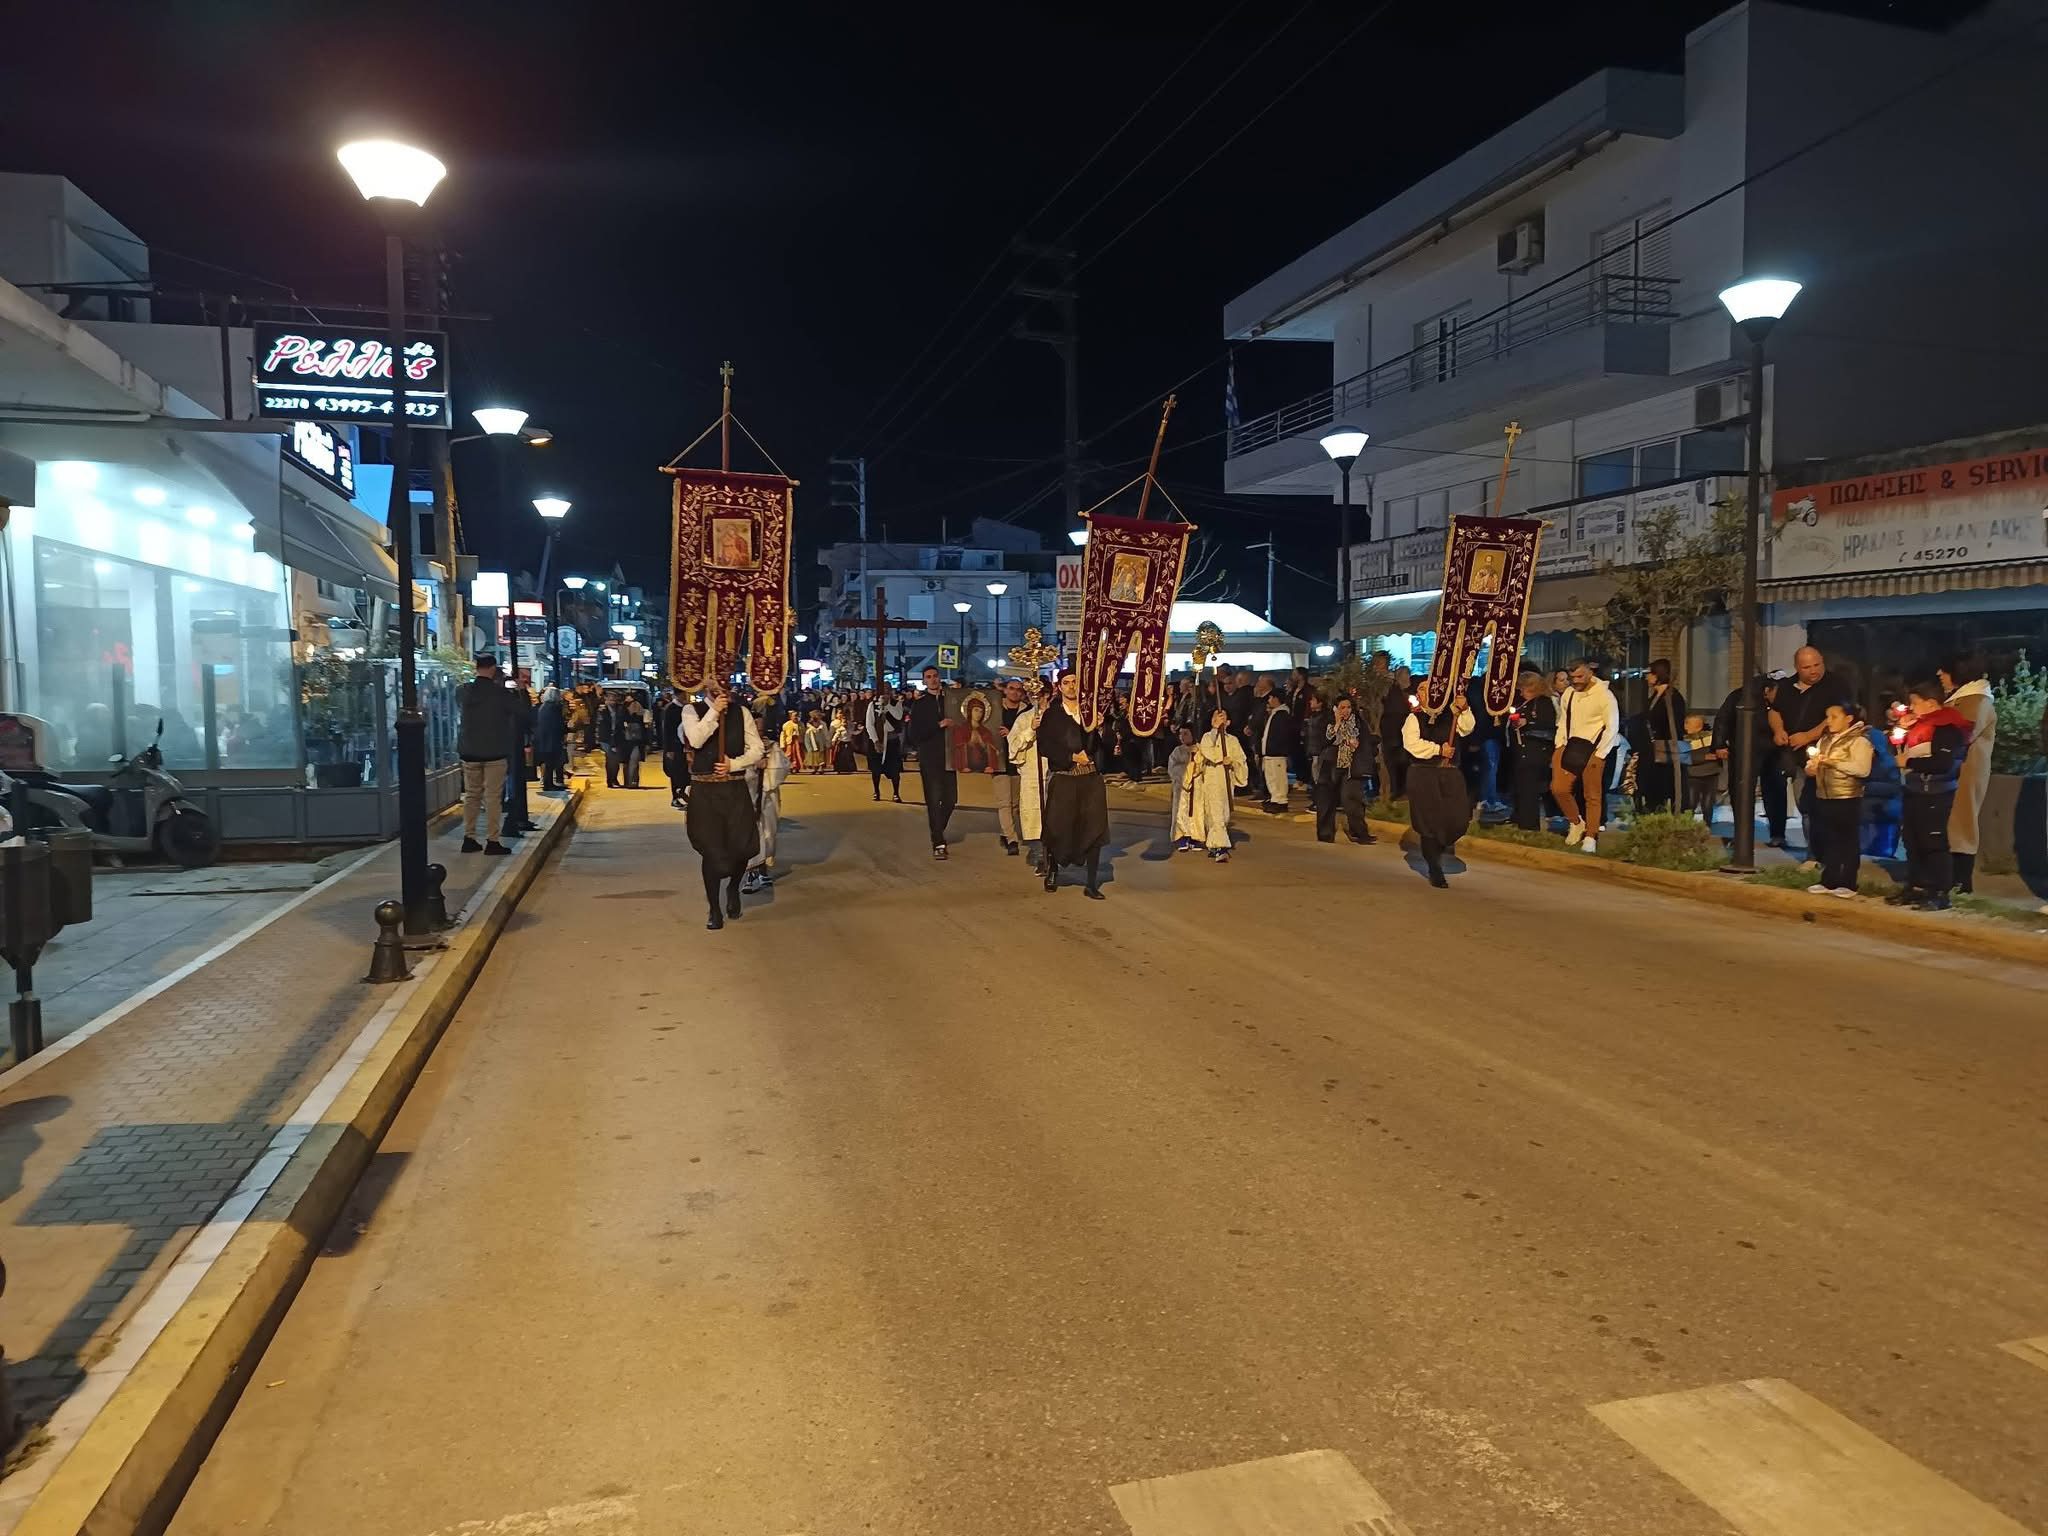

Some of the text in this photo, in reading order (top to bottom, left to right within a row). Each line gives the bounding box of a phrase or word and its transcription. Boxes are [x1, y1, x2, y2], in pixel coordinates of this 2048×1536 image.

[264, 397, 310, 410] 22210
[1830, 472, 1927, 505] ΠΩΛΗΣΕΙΣ
[1941, 470, 1955, 489] &
[1913, 547, 1968, 562] 45270
